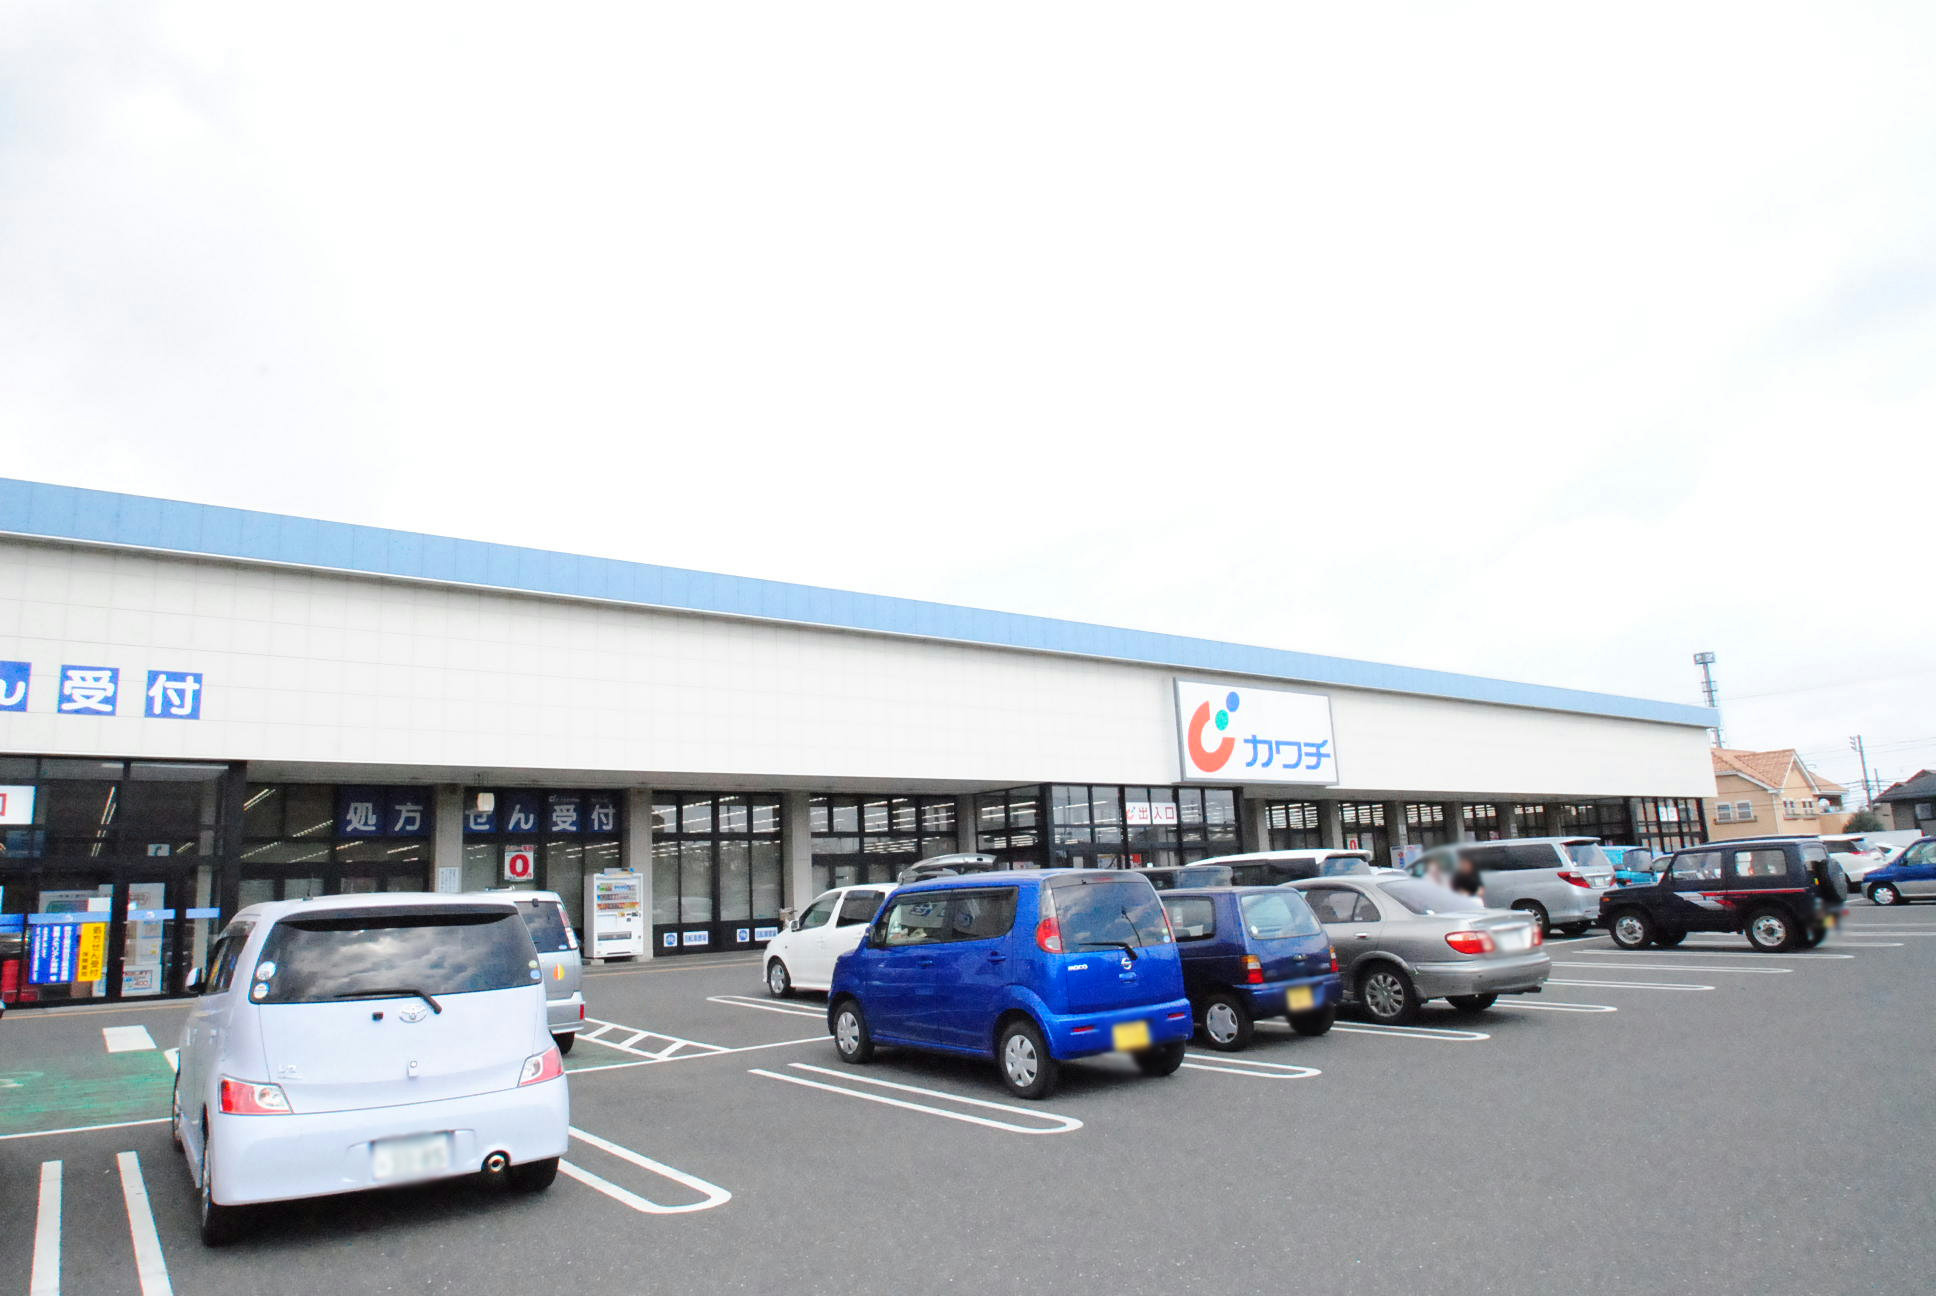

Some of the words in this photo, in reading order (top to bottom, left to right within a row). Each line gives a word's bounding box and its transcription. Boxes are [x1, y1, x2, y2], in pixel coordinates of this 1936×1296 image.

[1243, 734, 1331, 770] カワチ
[1138, 806, 1175, 820] 出入口
